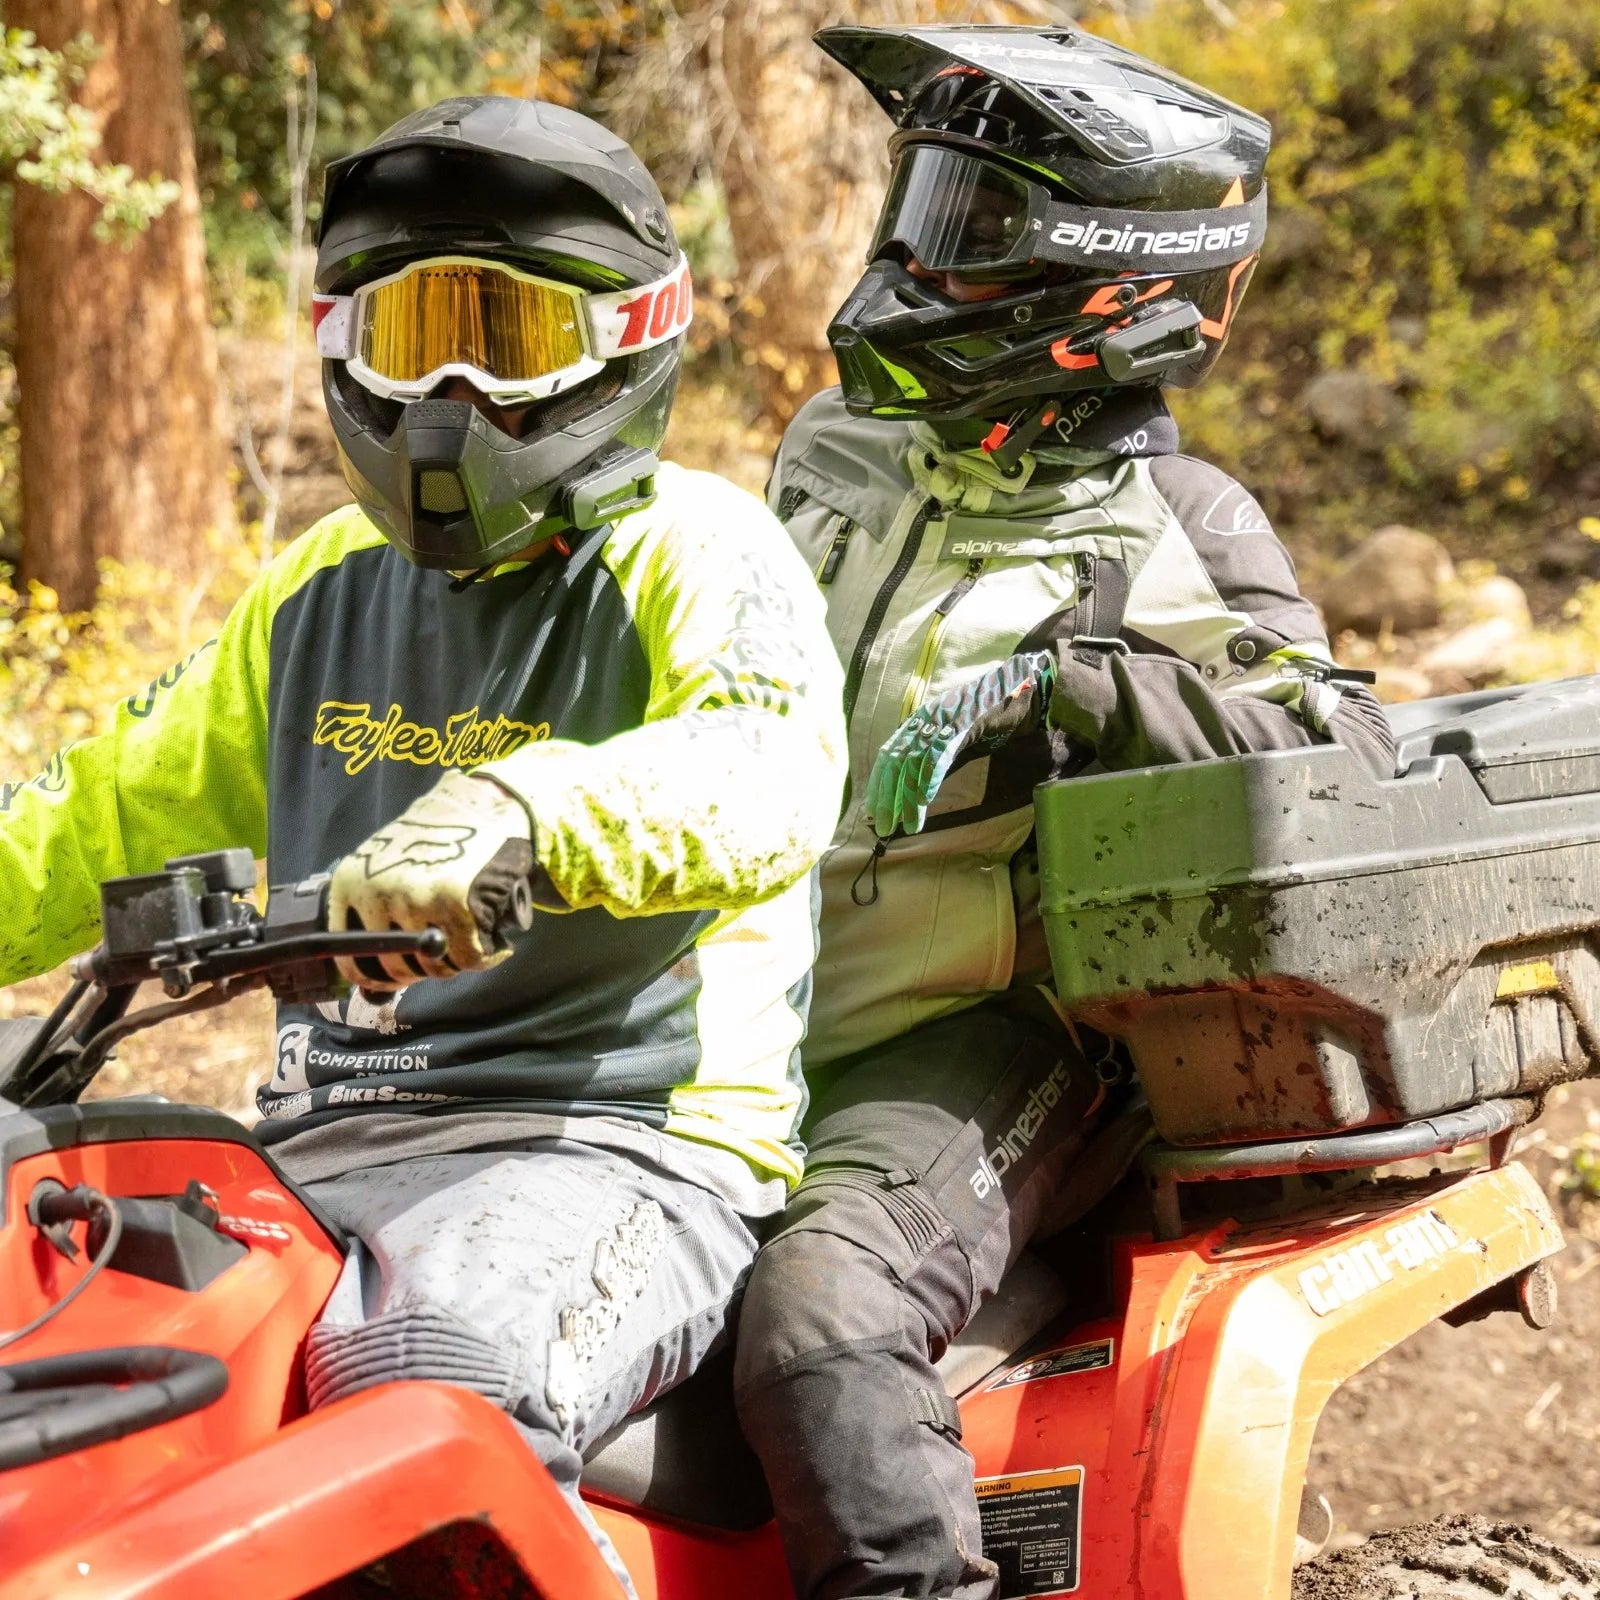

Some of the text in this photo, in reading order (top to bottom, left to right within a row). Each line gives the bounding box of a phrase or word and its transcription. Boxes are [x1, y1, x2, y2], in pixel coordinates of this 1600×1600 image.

[1050, 220, 1251, 255] alpinestars
[308, 1050, 428, 1071] COMPETITION
[969, 1059, 1072, 1200] alpinestars
